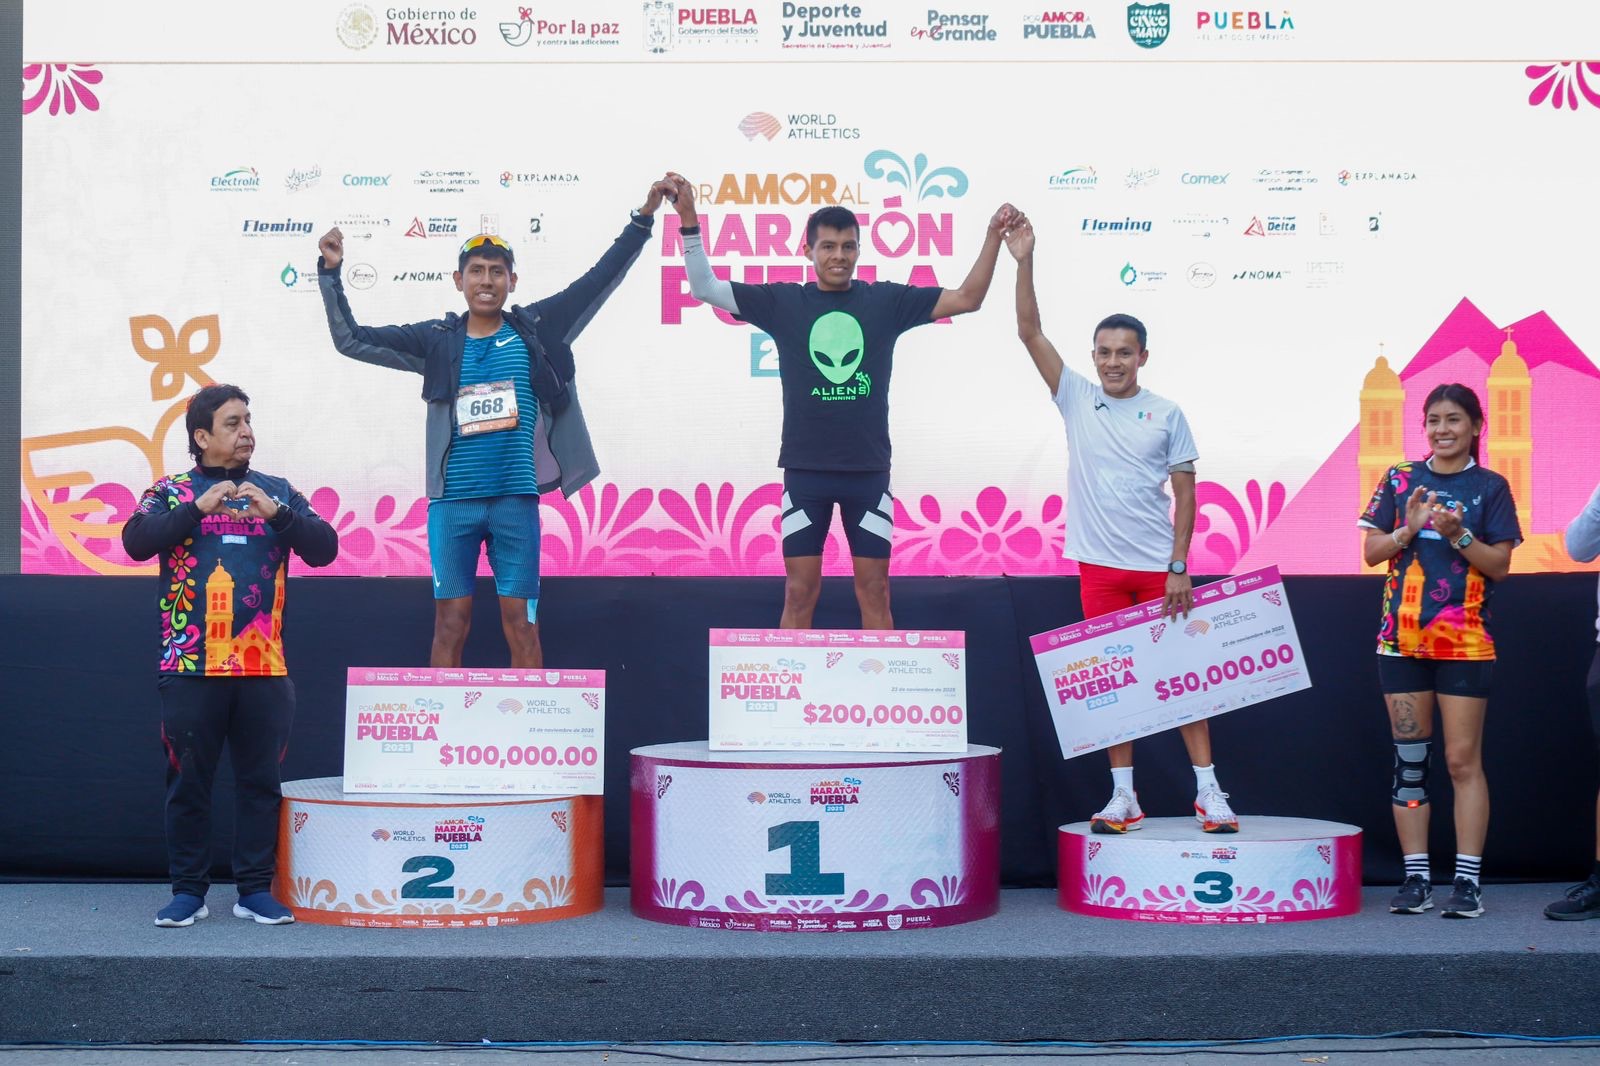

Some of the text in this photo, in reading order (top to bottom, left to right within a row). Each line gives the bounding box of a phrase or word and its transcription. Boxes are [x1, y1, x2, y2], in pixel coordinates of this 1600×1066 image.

[386, 7, 477, 20] Gobierno de
[678, 9, 757, 25] PUEBLA
[783, 2, 862, 23] Deporte
[928, 10, 989, 26] Pensar
[1042, 12, 1084, 23] AMOR
[1130, 15, 1168, 28] CINCO
[1197, 11, 1294, 29] PUEBLA
[387, 22, 477, 45] México
[537, 20, 619, 38] Por la paz
[678, 27, 758, 36] Gobierno del Estado
[782, 21, 887, 42] y Juventud
[930, 25, 997, 41] Grande
[1024, 24, 1096, 39] PUEBLA
[1136, 27, 1167, 38] MAYO
[788, 114, 836, 126] WORLD
[788, 128, 860, 140] ATHLETICS
[211, 176, 260, 187] Electrolit
[343, 174, 392, 187] Comex
[517, 174, 580, 182] EXPLANADA
[1050, 176, 1098, 185] Electrolit
[1181, 173, 1230, 185] Comex
[1356, 172, 1417, 180] EXPLANADA
[715, 173, 837, 205] AMOR
[839, 183, 870, 204] AL
[243, 219, 313, 234] Fleming
[428, 223, 457, 232] Delta
[1082, 217, 1152, 232] Fleming
[1268, 222, 1296, 231] Delta
[410, 272, 443, 281] NOMA
[1249, 270, 1282, 279] NOMA
[470, 397, 504, 417] 668
[201, 523, 266, 535] PUEBLA
[1211, 609, 1241, 622] WORLD
[1214, 612, 1257, 630] ATHLETICS
[736, 663, 770, 671] AMOR
[1066, 656, 1099, 673] AMOR
[721, 669, 802, 684] MARATÓN
[1055, 656, 1134, 689] MARATÓN
[1154, 644, 1294, 702] $50,000.00
[721, 685, 802, 700] PUEBLA
[1057, 670, 1138, 705] PUEBLA
[373, 703, 407, 711] AMOR
[748, 702, 775, 711] 2025
[1087, 694, 1116, 708] 2025
[358, 710, 440, 724] MARATÓN
[803, 702, 963, 727] $200,000.00
[357, 725, 438, 741] PUEBLA
[384, 743, 411, 752] 2025
[439, 743, 598, 768] $100,000.00
[811, 785, 859, 794] MARATÓN
[811, 795, 859, 805] PUEBLA
[435, 823, 482, 832] MARATÓN
[435, 833, 482, 842] PUEBLA
[765, 821, 845, 895] 1
[401, 855, 455, 898] 2
[1193, 871, 1233, 904] 3
[700, 920, 720, 928] México
